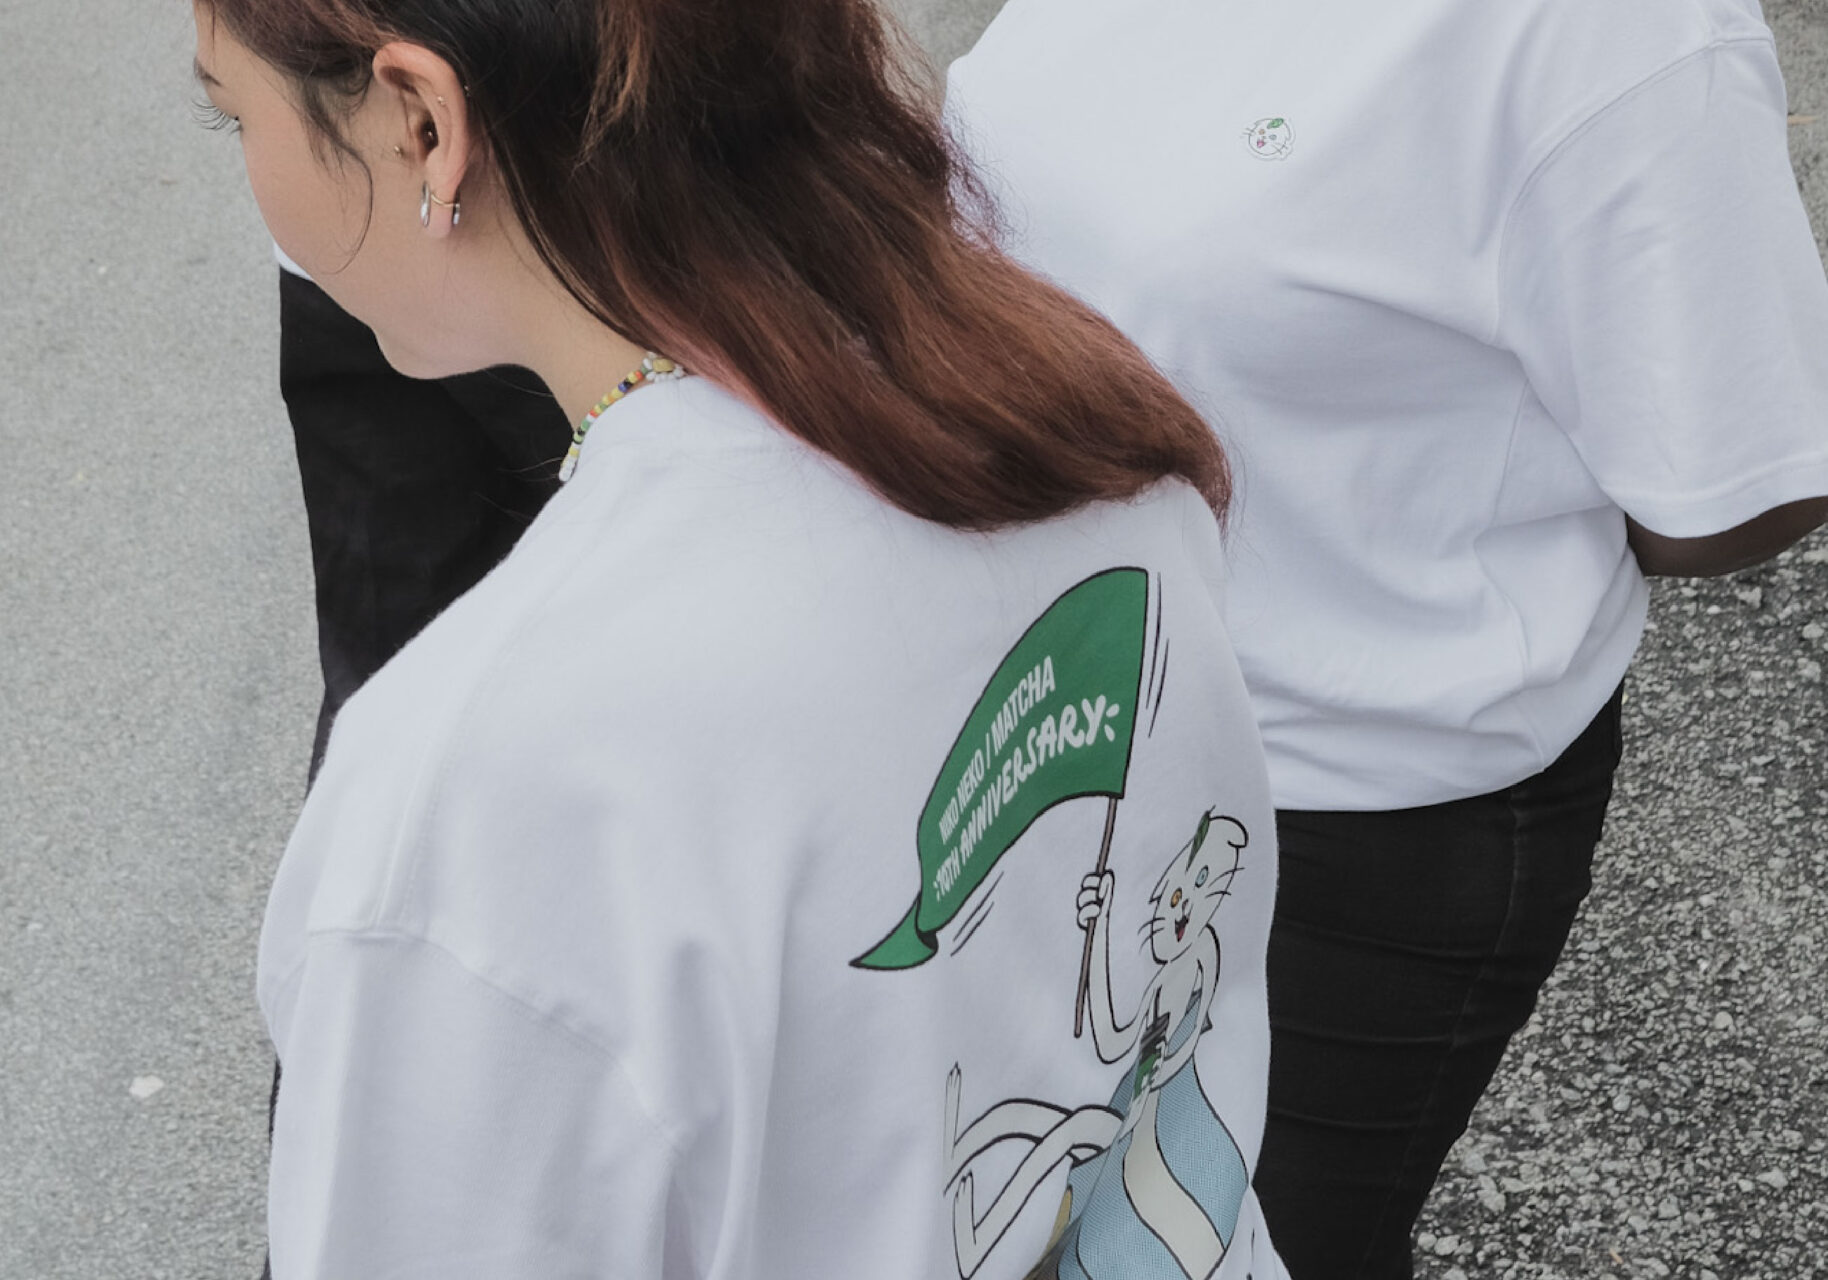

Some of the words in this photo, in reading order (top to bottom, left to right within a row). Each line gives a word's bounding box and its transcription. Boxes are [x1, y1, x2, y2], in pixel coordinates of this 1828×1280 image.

[957, 749, 984, 812] NEKO
[990, 655, 1056, 756] MATCHA
[960, 694, 1107, 865] ANNIVERSARY
